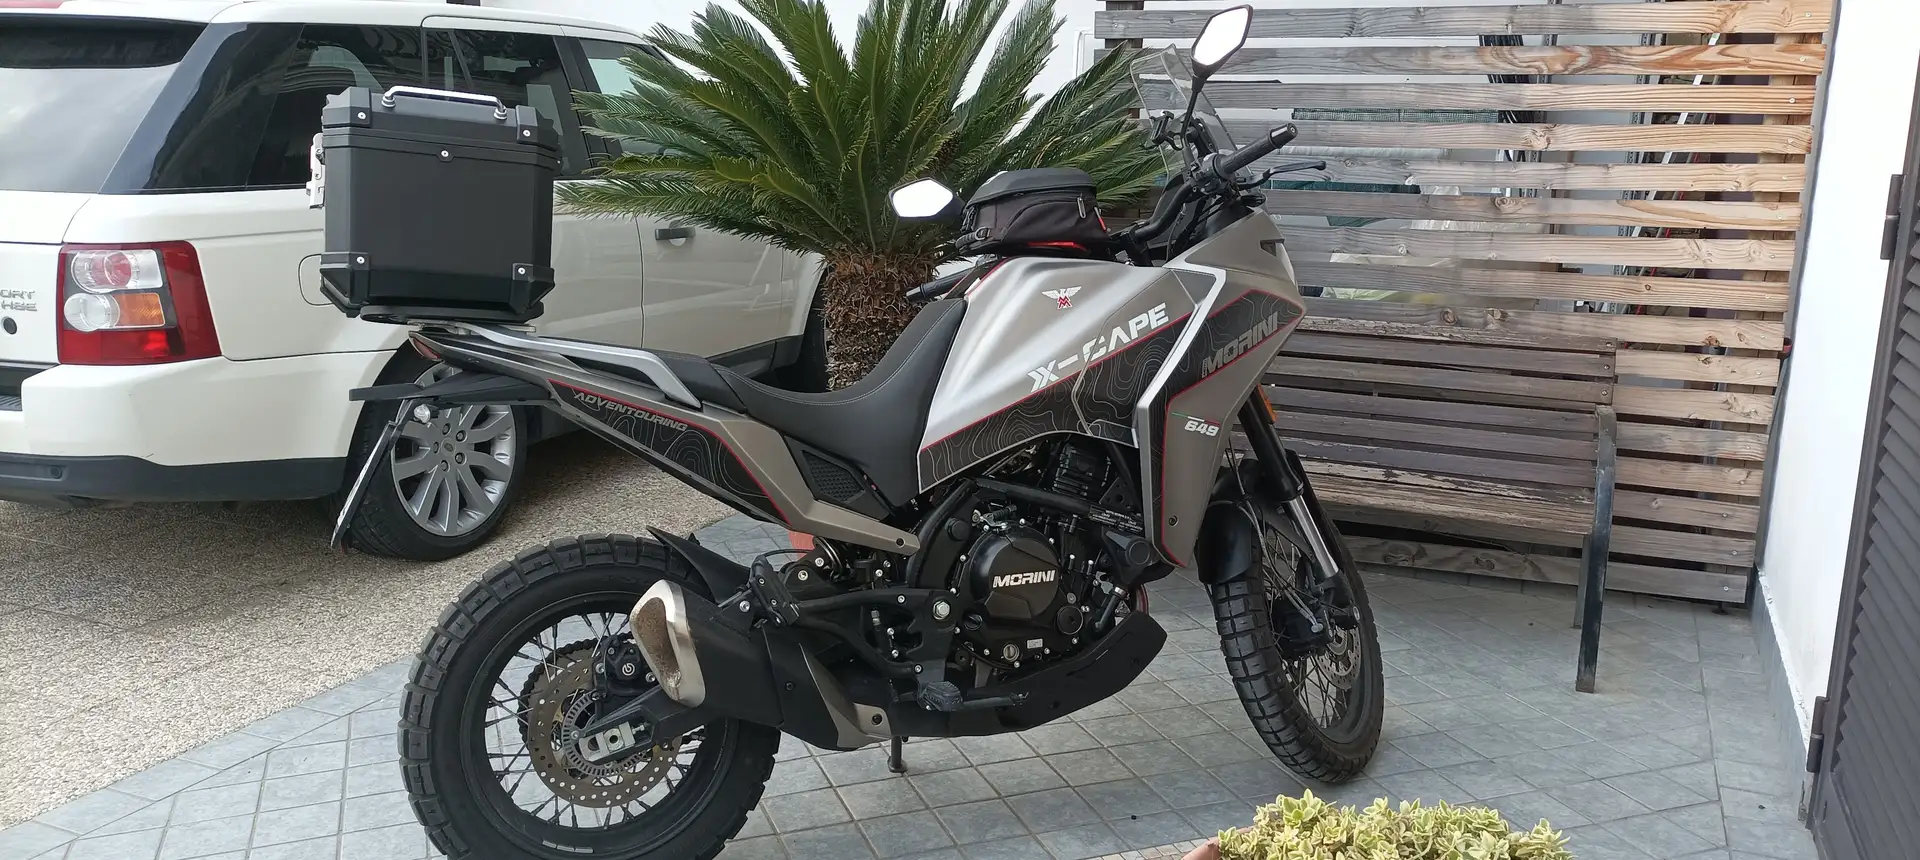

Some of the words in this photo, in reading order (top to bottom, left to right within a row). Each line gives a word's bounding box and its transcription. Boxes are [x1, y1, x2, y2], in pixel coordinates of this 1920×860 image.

[1027, 302, 1169, 393] X-CAPE
[1201, 311, 1278, 378] MORINI
[574, 392, 688, 431] ADVENTOURING
[1184, 420, 1219, 437] 649
[992, 569, 1056, 588] MORINI
